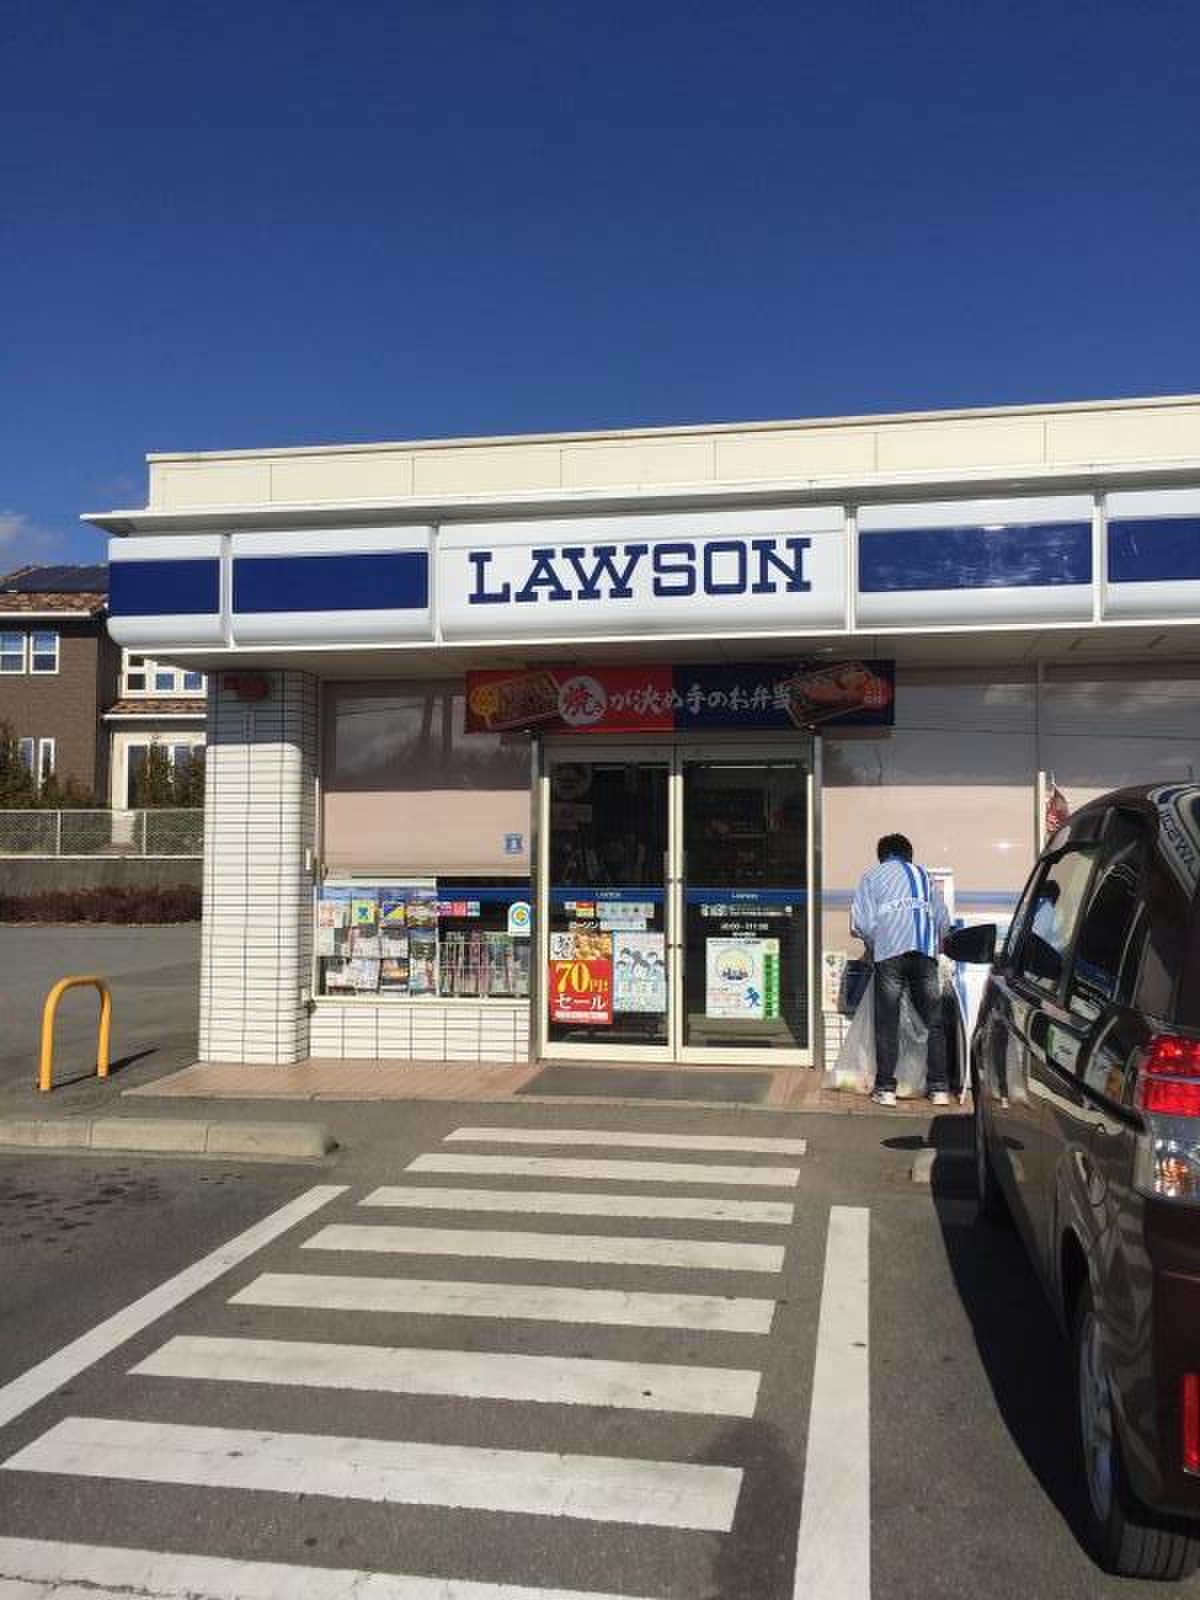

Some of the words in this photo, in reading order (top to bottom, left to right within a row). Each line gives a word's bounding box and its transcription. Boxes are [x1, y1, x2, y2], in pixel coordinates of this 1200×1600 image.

[468, 538, 812, 604] LAWSON
[555, 992, 606, 1010] セール
